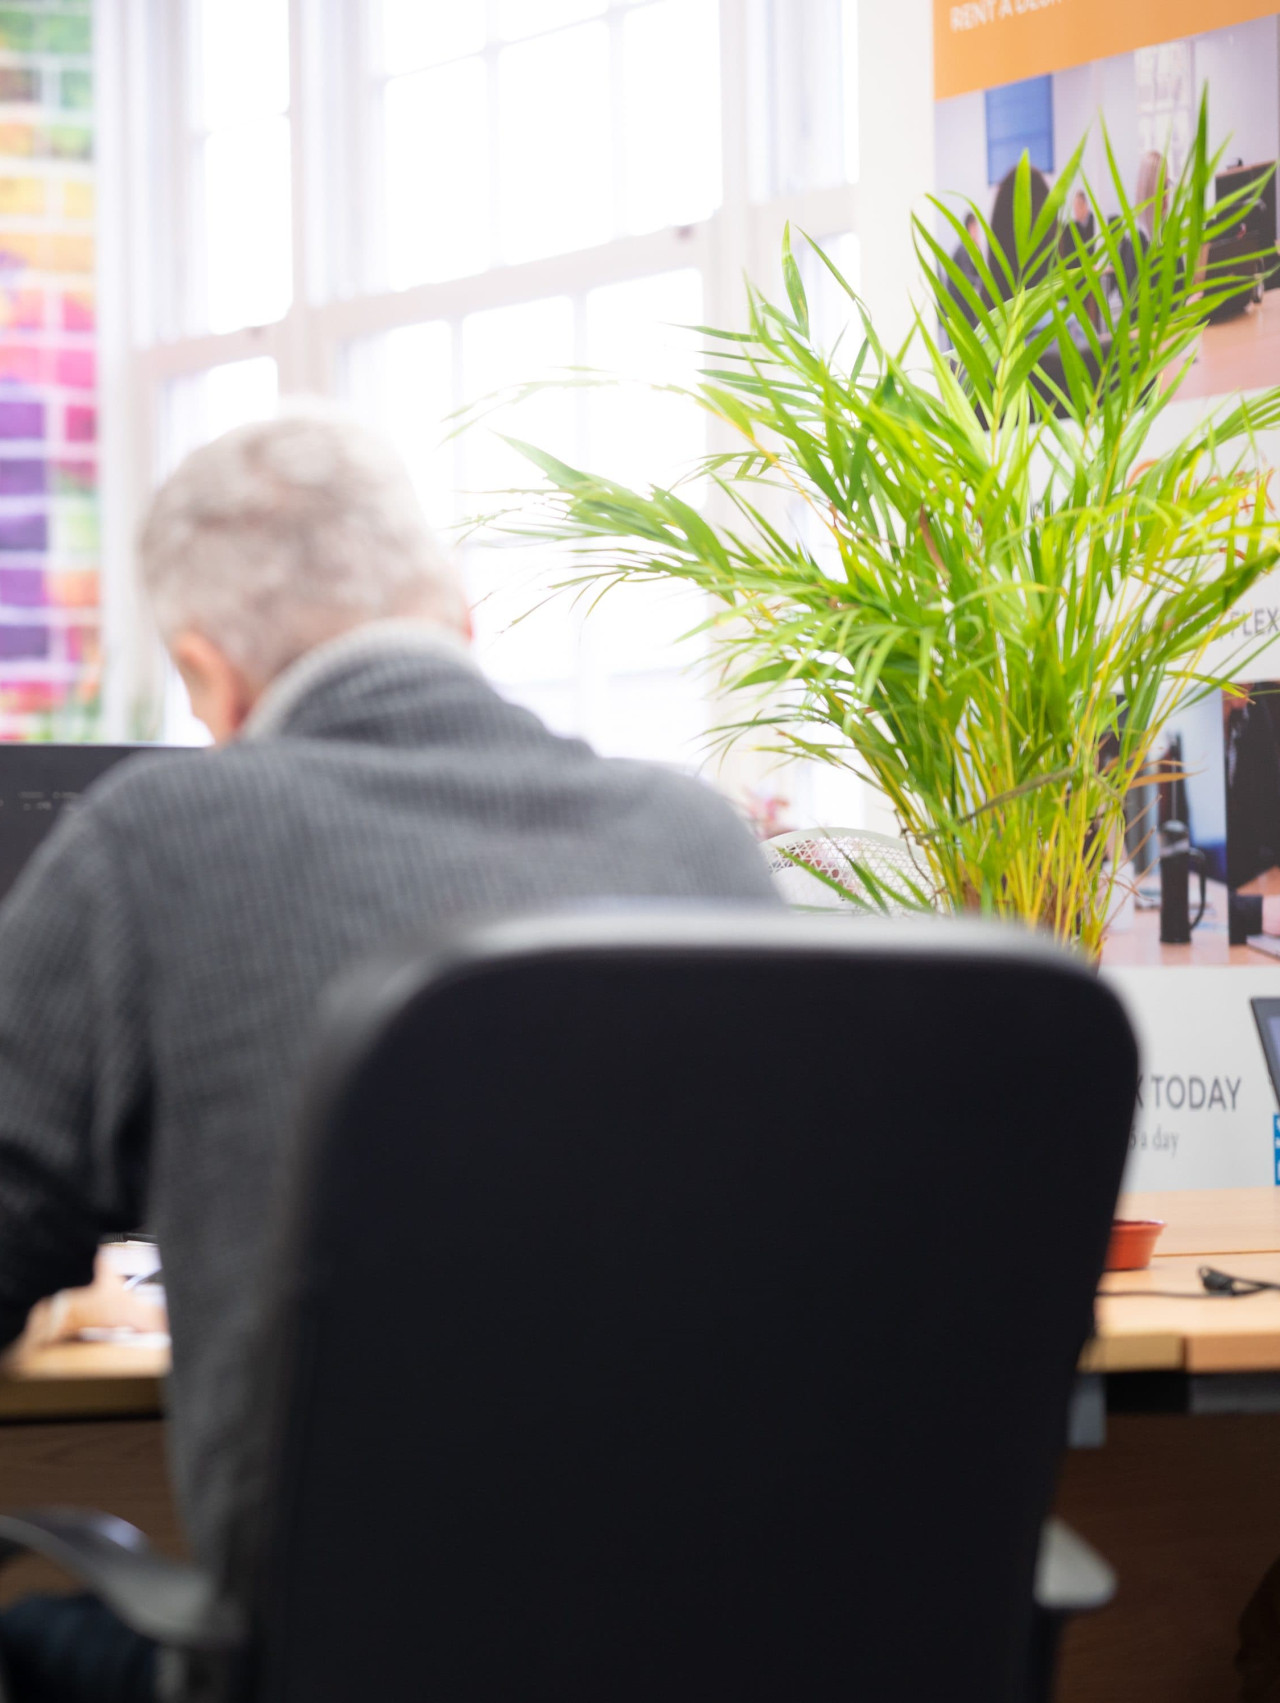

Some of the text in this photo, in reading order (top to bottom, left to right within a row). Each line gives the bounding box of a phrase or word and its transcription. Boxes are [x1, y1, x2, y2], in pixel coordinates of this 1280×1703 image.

[950, 0, 995, 33] RENT
[1151, 1074, 1242, 1111] TODAY
[1152, 1123, 1180, 1158] day
